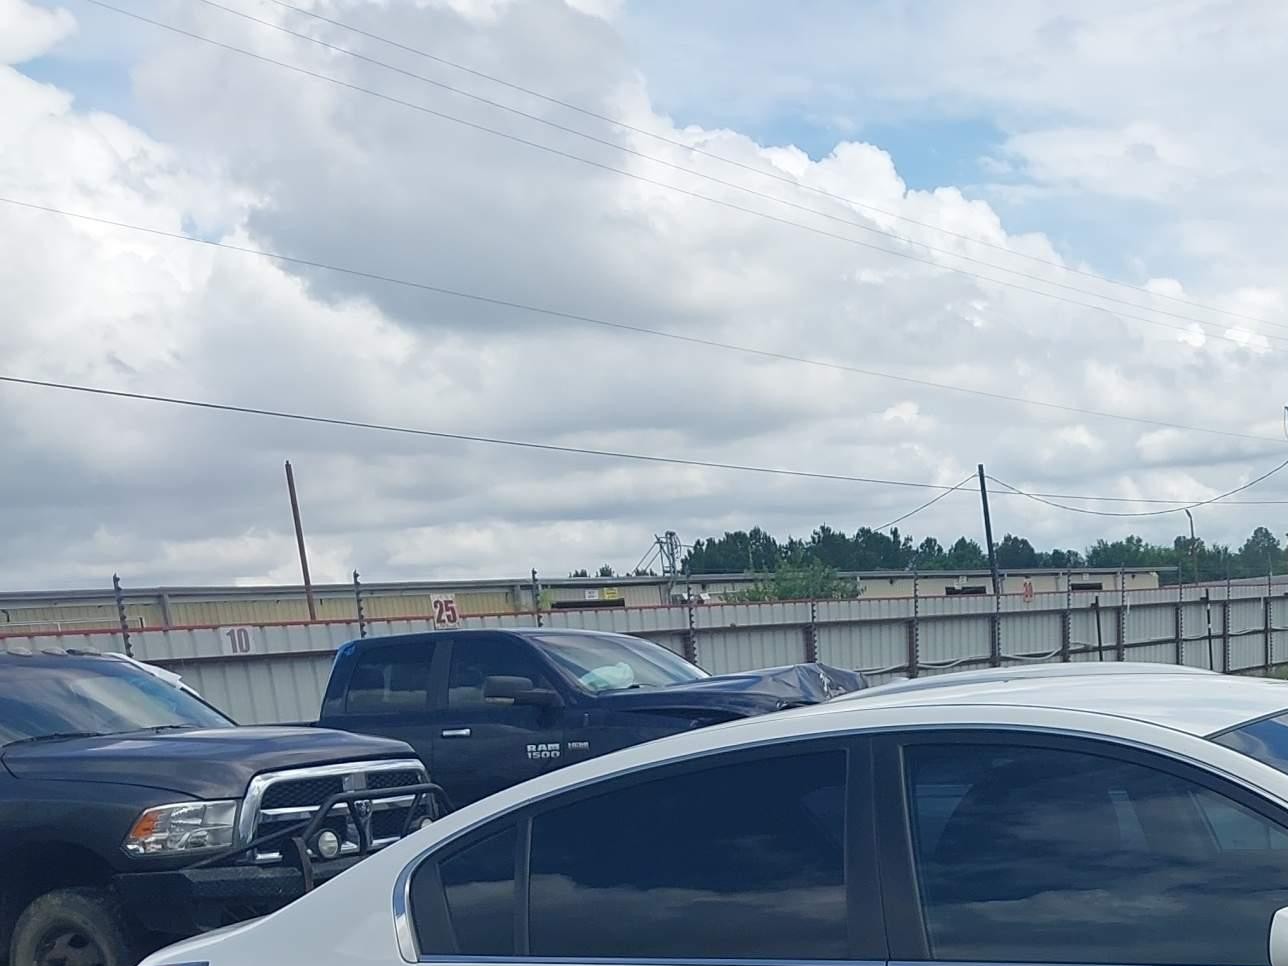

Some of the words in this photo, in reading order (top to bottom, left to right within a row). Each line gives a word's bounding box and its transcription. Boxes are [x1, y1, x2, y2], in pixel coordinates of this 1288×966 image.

[433, 599, 458, 624] 25
[226, 628, 250, 653] 10
[526, 743, 560, 752] RAM
[527, 751, 560, 759] 1500
